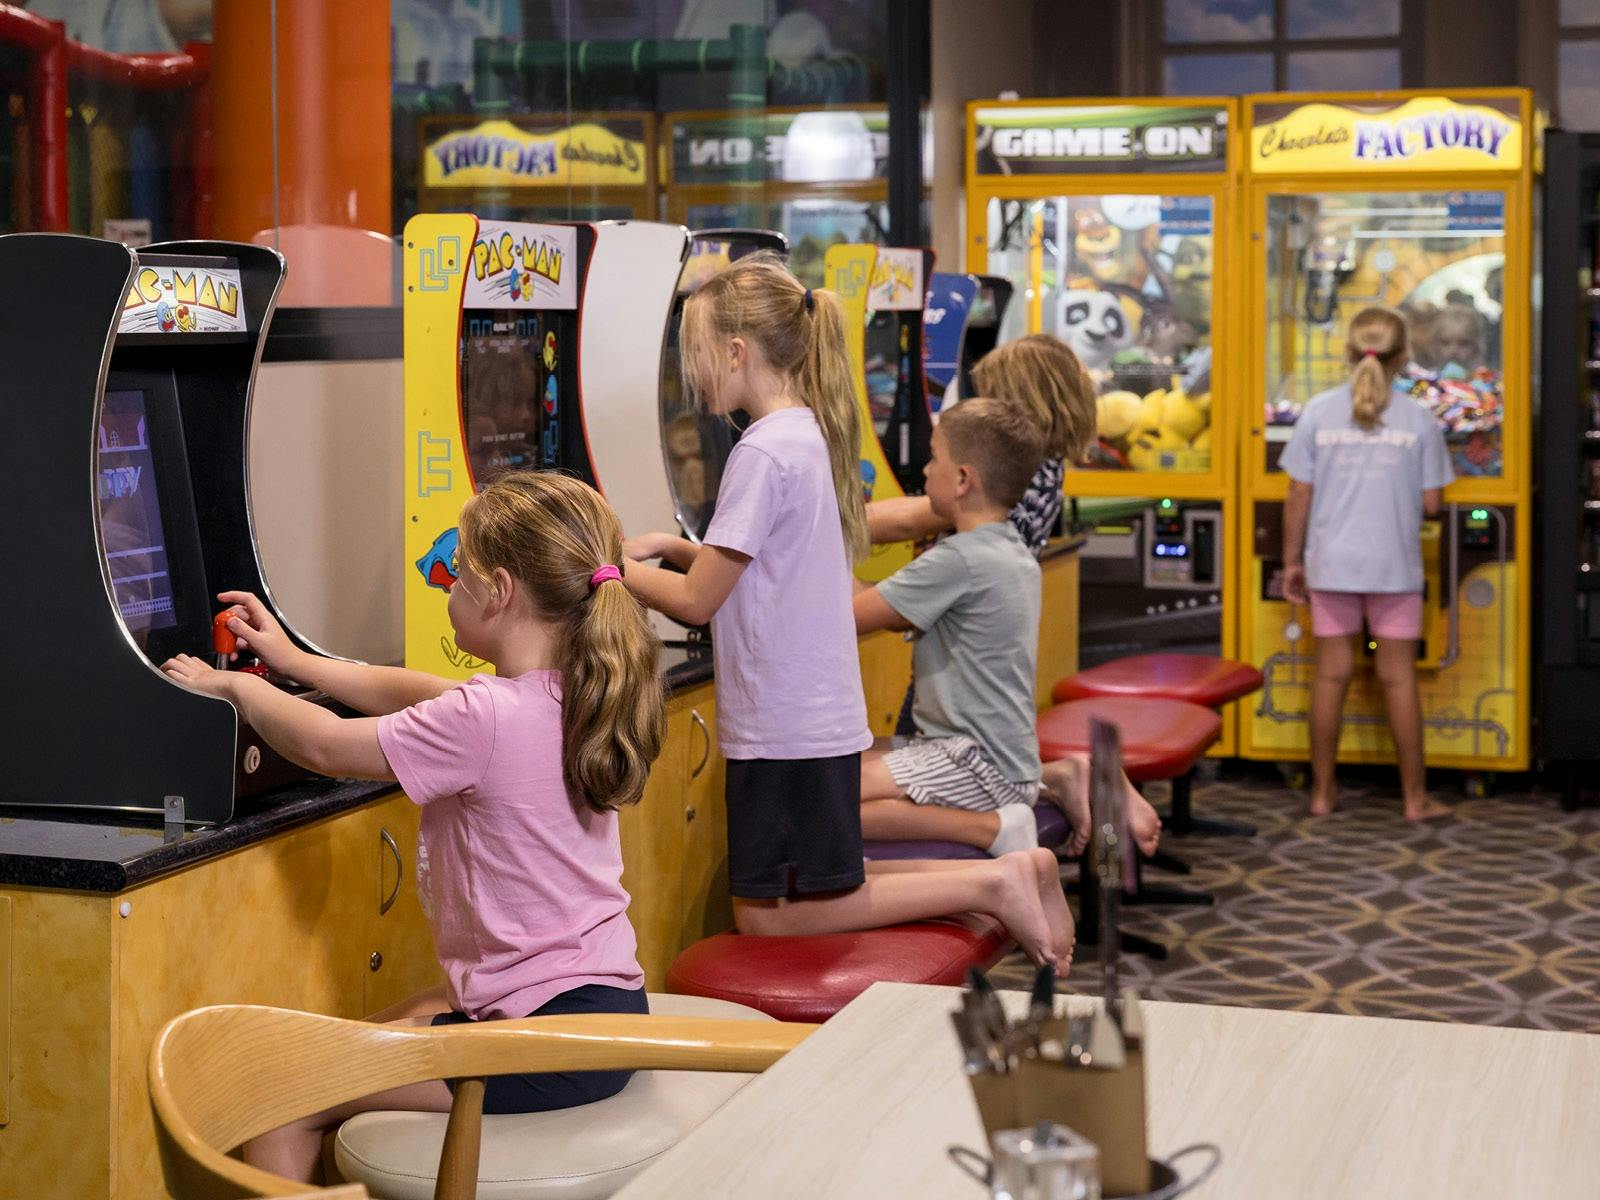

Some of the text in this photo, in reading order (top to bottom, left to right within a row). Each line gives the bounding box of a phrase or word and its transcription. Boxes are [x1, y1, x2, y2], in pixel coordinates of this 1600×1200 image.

[1355, 110, 1510, 159] FACTORY
[474, 231, 562, 286] PAC-MAN
[122, 267, 238, 318] AC-MAN
